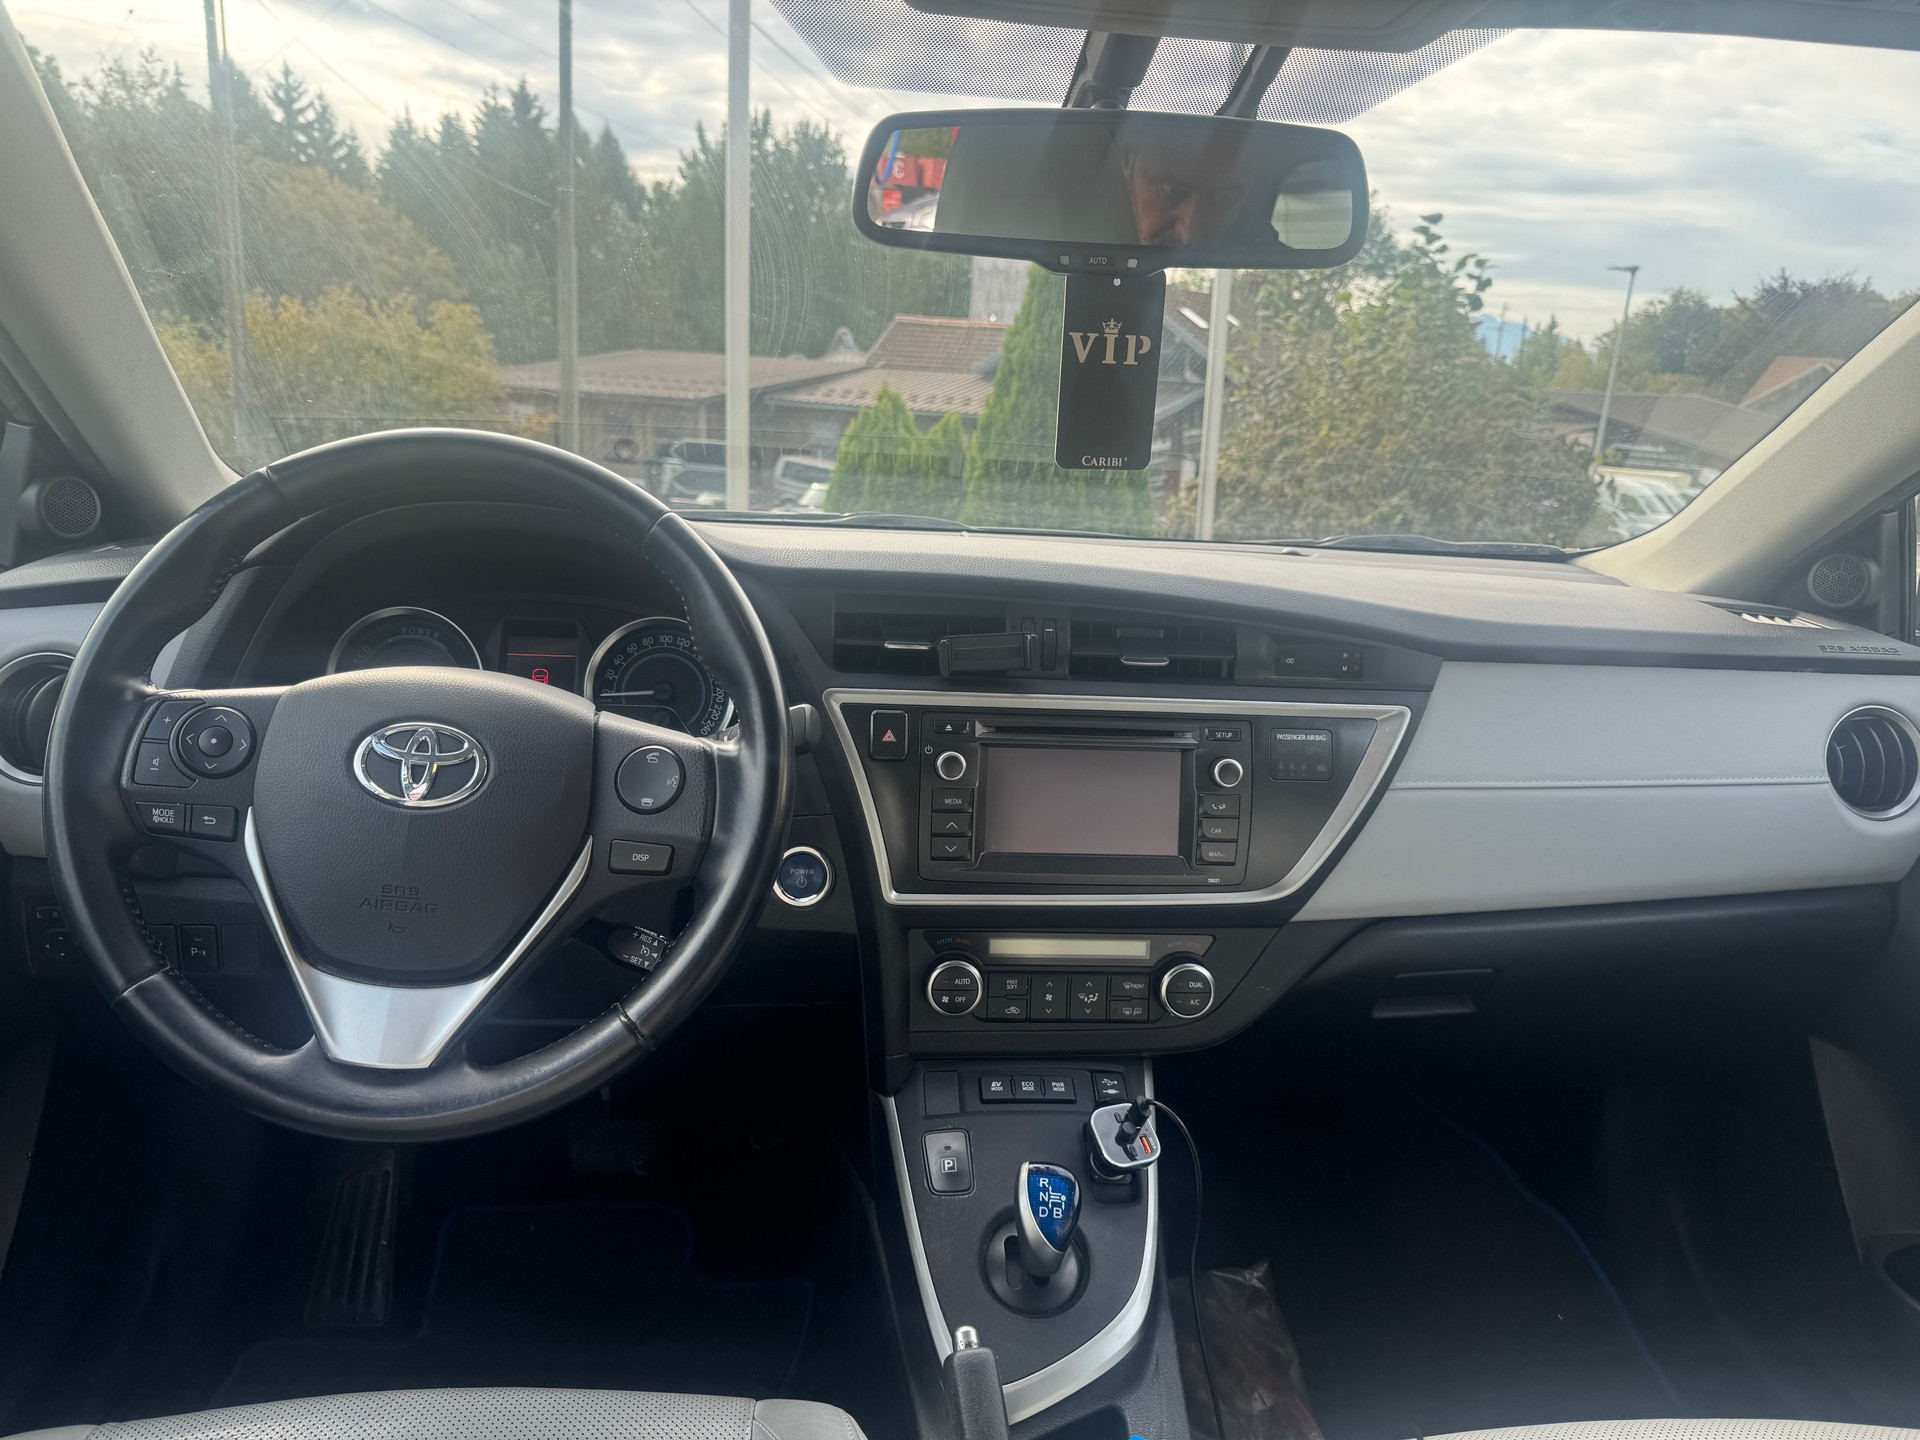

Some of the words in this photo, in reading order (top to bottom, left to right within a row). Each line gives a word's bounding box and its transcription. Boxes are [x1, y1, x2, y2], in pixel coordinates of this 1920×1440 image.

[1089, 257, 1107, 265] AUTO
[1068, 331, 1152, 365] VIP
[401, 626, 440, 640] POWER
[642, 636, 654, 646] 80
[659, 635, 673, 644] 100
[676, 636, 691, 648] 120
[626, 642, 638, 654] 60
[354, 645, 371, 664] ECO
[614, 654, 625, 665] 40
[604, 669, 615, 680] 20
[716, 687, 725, 703] 200
[711, 704, 723, 721] 220
[700, 720, 715, 736] 240
[1215, 731, 1233, 739] SETUP
[152, 808, 175, 817] MODE
[632, 853, 650, 861] DISP
[382, 884, 420, 896] SRS
[360, 897, 438, 913] AIRBAG
[639, 933, 653, 944] RES
[190, 947, 198, 956] P
[629, 955, 643, 966] SET
[1189, 998, 1200, 1006] A/C
[944, 1159, 954, 1171] P
[1039, 1177, 1049, 1188] R
[1039, 1192, 1048, 1201] N
[1039, 1207, 1048, 1217] D
[1053, 1208, 1063, 1218] B
